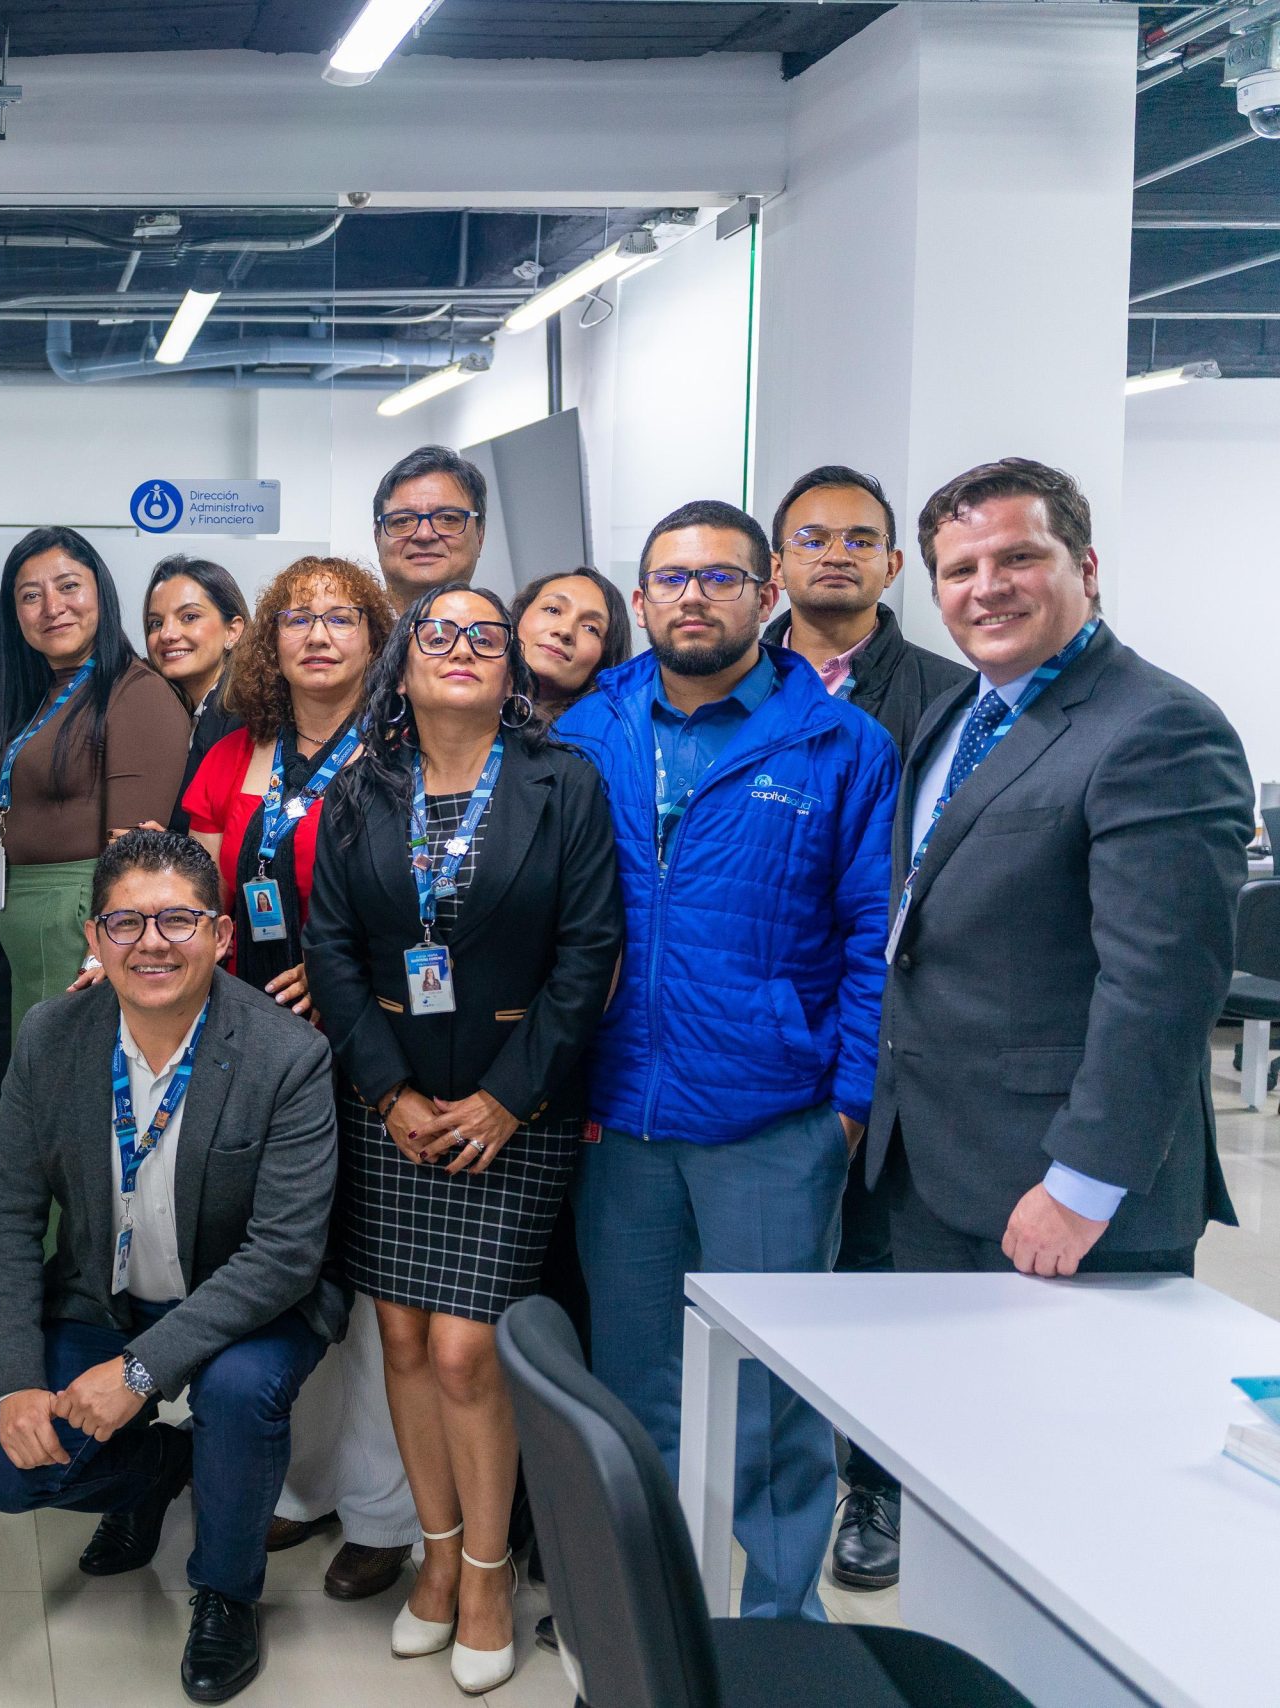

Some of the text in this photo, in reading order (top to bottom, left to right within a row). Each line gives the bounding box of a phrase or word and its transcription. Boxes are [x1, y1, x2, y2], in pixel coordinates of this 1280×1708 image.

[190, 490, 239, 500] Dirección
[190, 502, 265, 512] Administrativa
[189, 514, 254, 526] y Financiera
